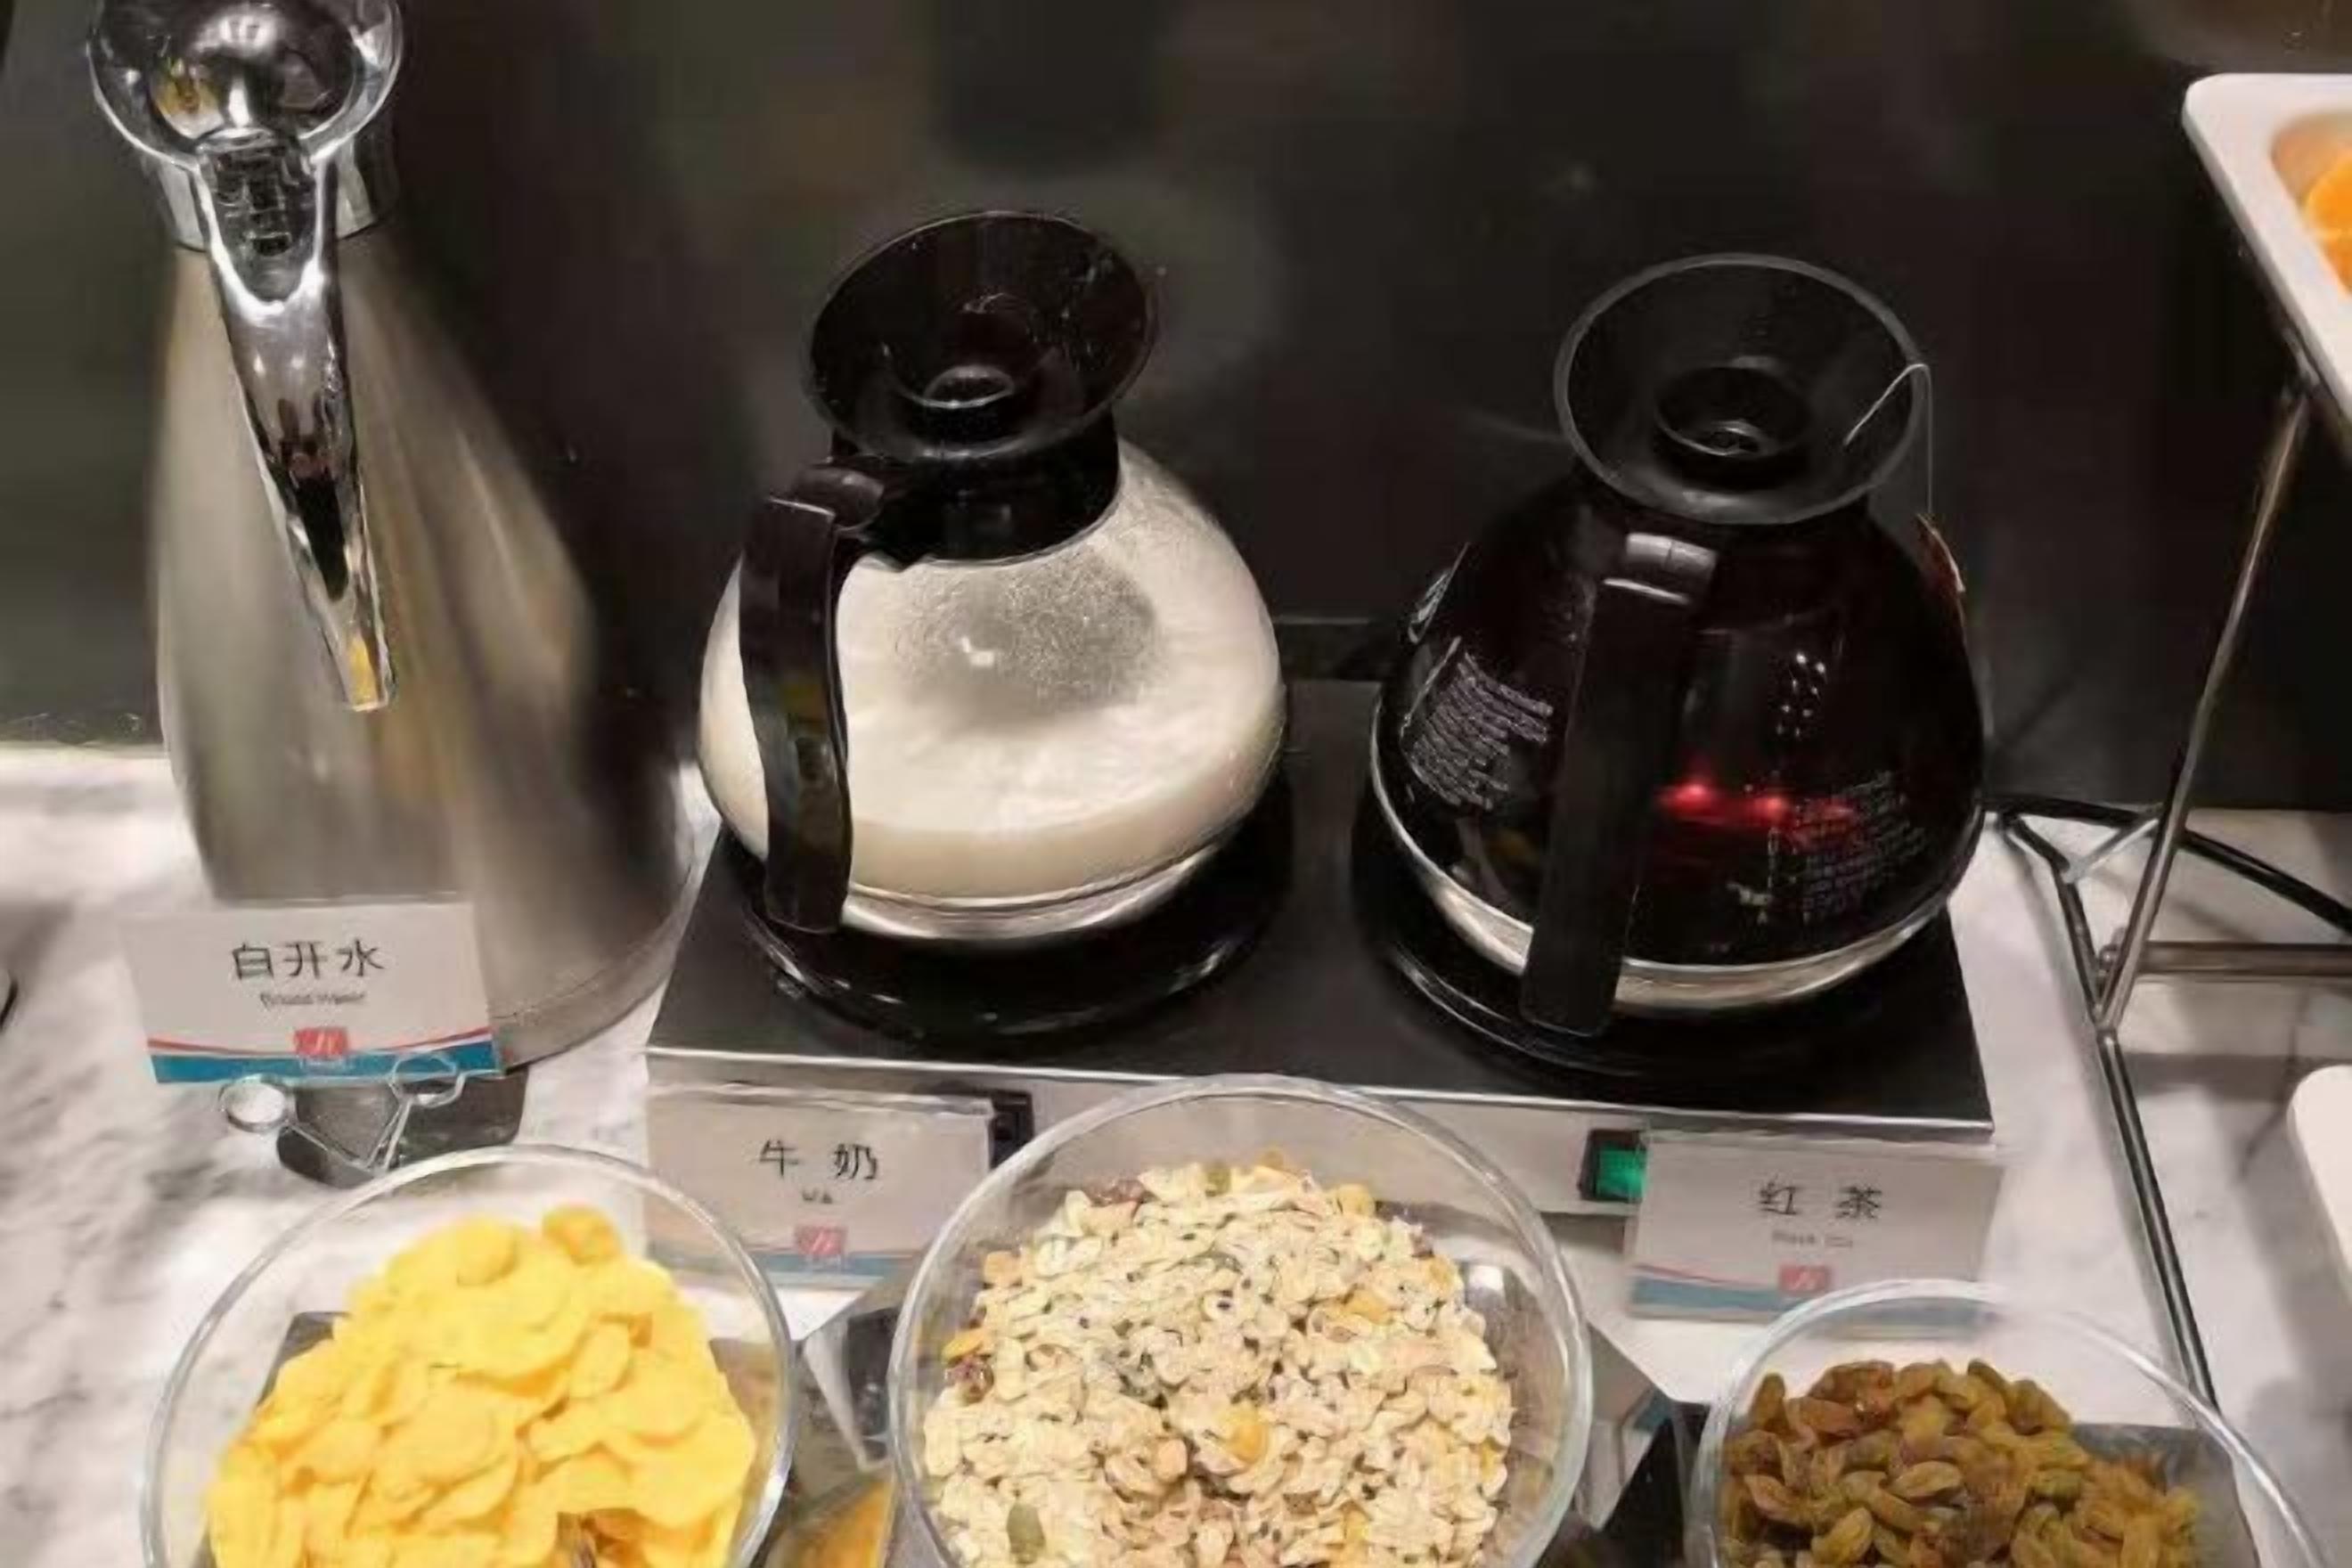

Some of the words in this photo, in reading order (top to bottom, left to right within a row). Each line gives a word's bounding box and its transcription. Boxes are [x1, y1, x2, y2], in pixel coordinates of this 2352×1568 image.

[232, 940, 385, 979] 白开水
[760, 1138, 878, 1180] 牛奶
[1759, 1177, 1882, 1220] 红茶
